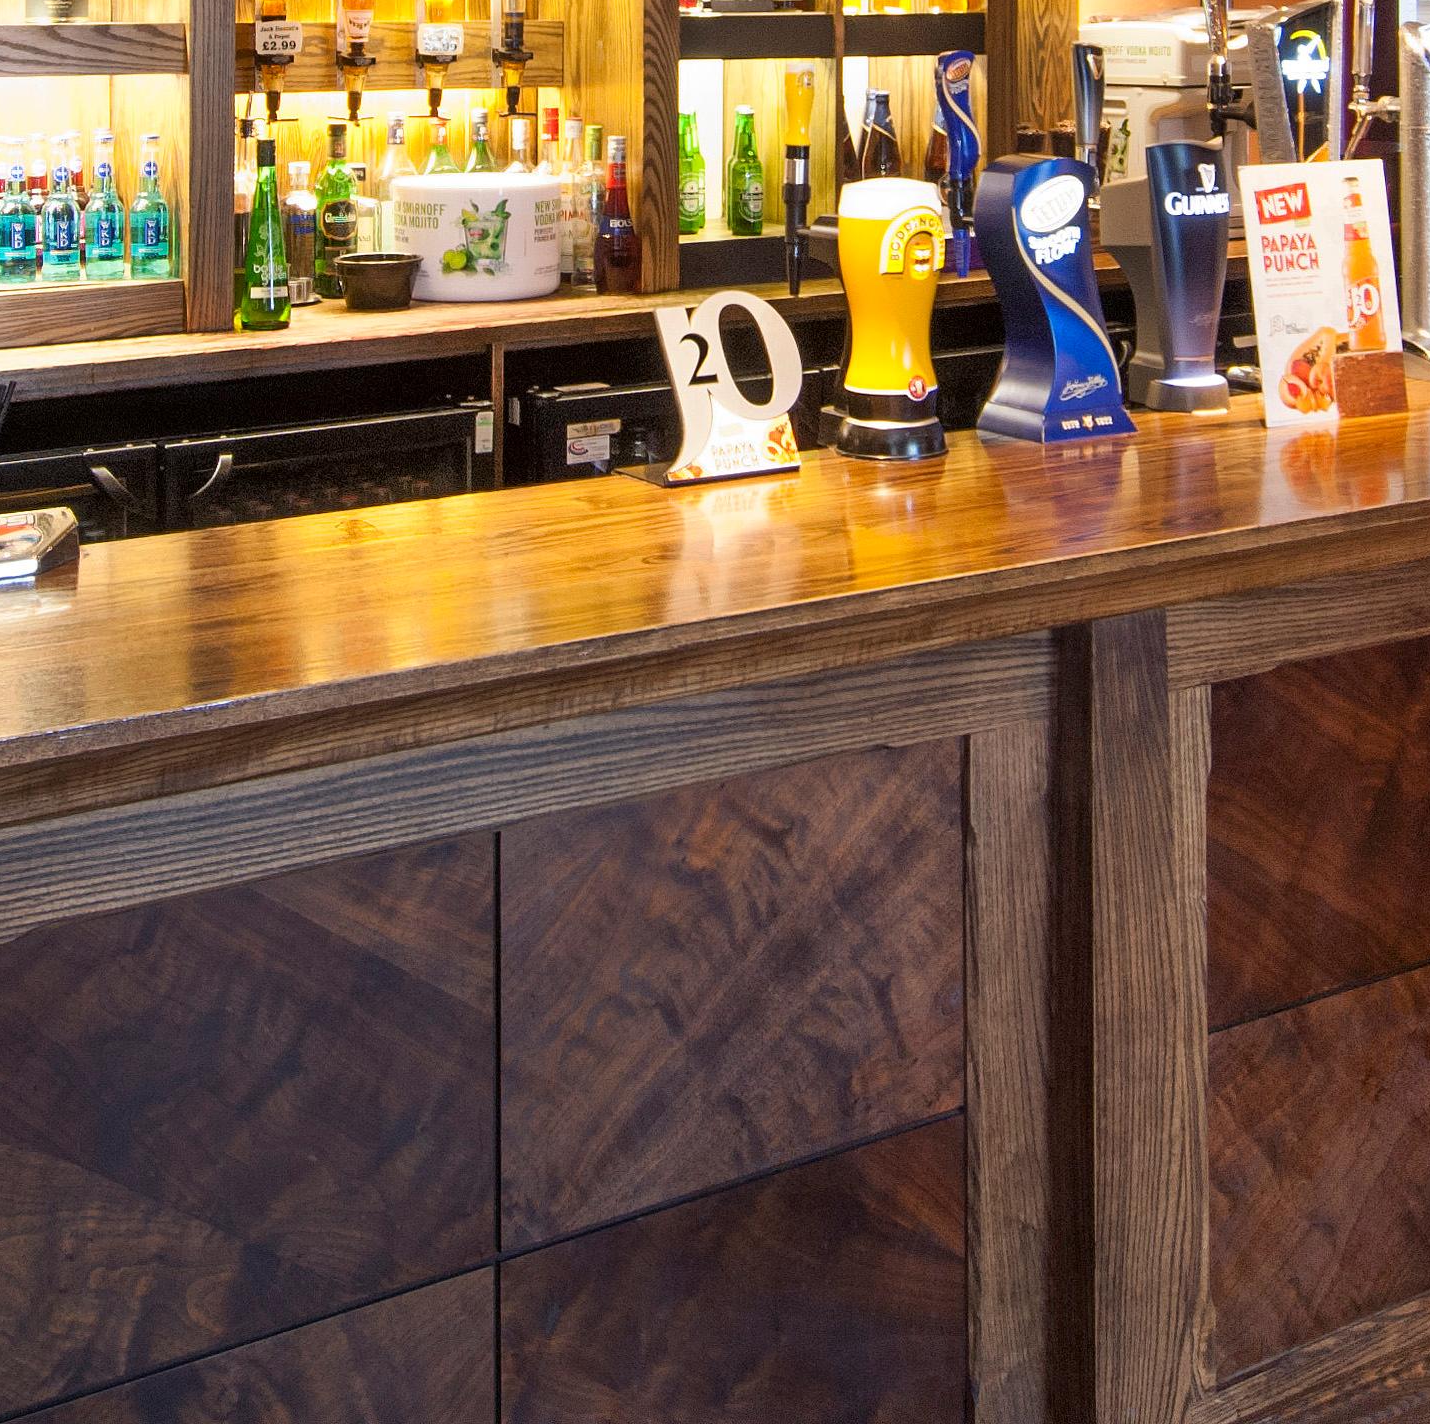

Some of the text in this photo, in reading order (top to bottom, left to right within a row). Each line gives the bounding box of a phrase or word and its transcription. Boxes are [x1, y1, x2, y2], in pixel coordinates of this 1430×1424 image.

[262, 40, 297, 52] £2.99
[402, 203, 446, 216] SMIRNOFF
[534, 200, 551, 213] NEW
[1259, 190, 1304, 219] NEW
[146, 220, 158, 245] WKD
[408, 216, 439, 229] MOJITO
[13, 223, 25, 249] WKD
[59, 221, 70, 247] WKD
[100, 220, 112, 246] WKD
[1260, 234, 1317, 254] PAPAYA
[1263, 253, 1320, 273] PUNCH
[711, 441, 755, 456] PAPAYA
